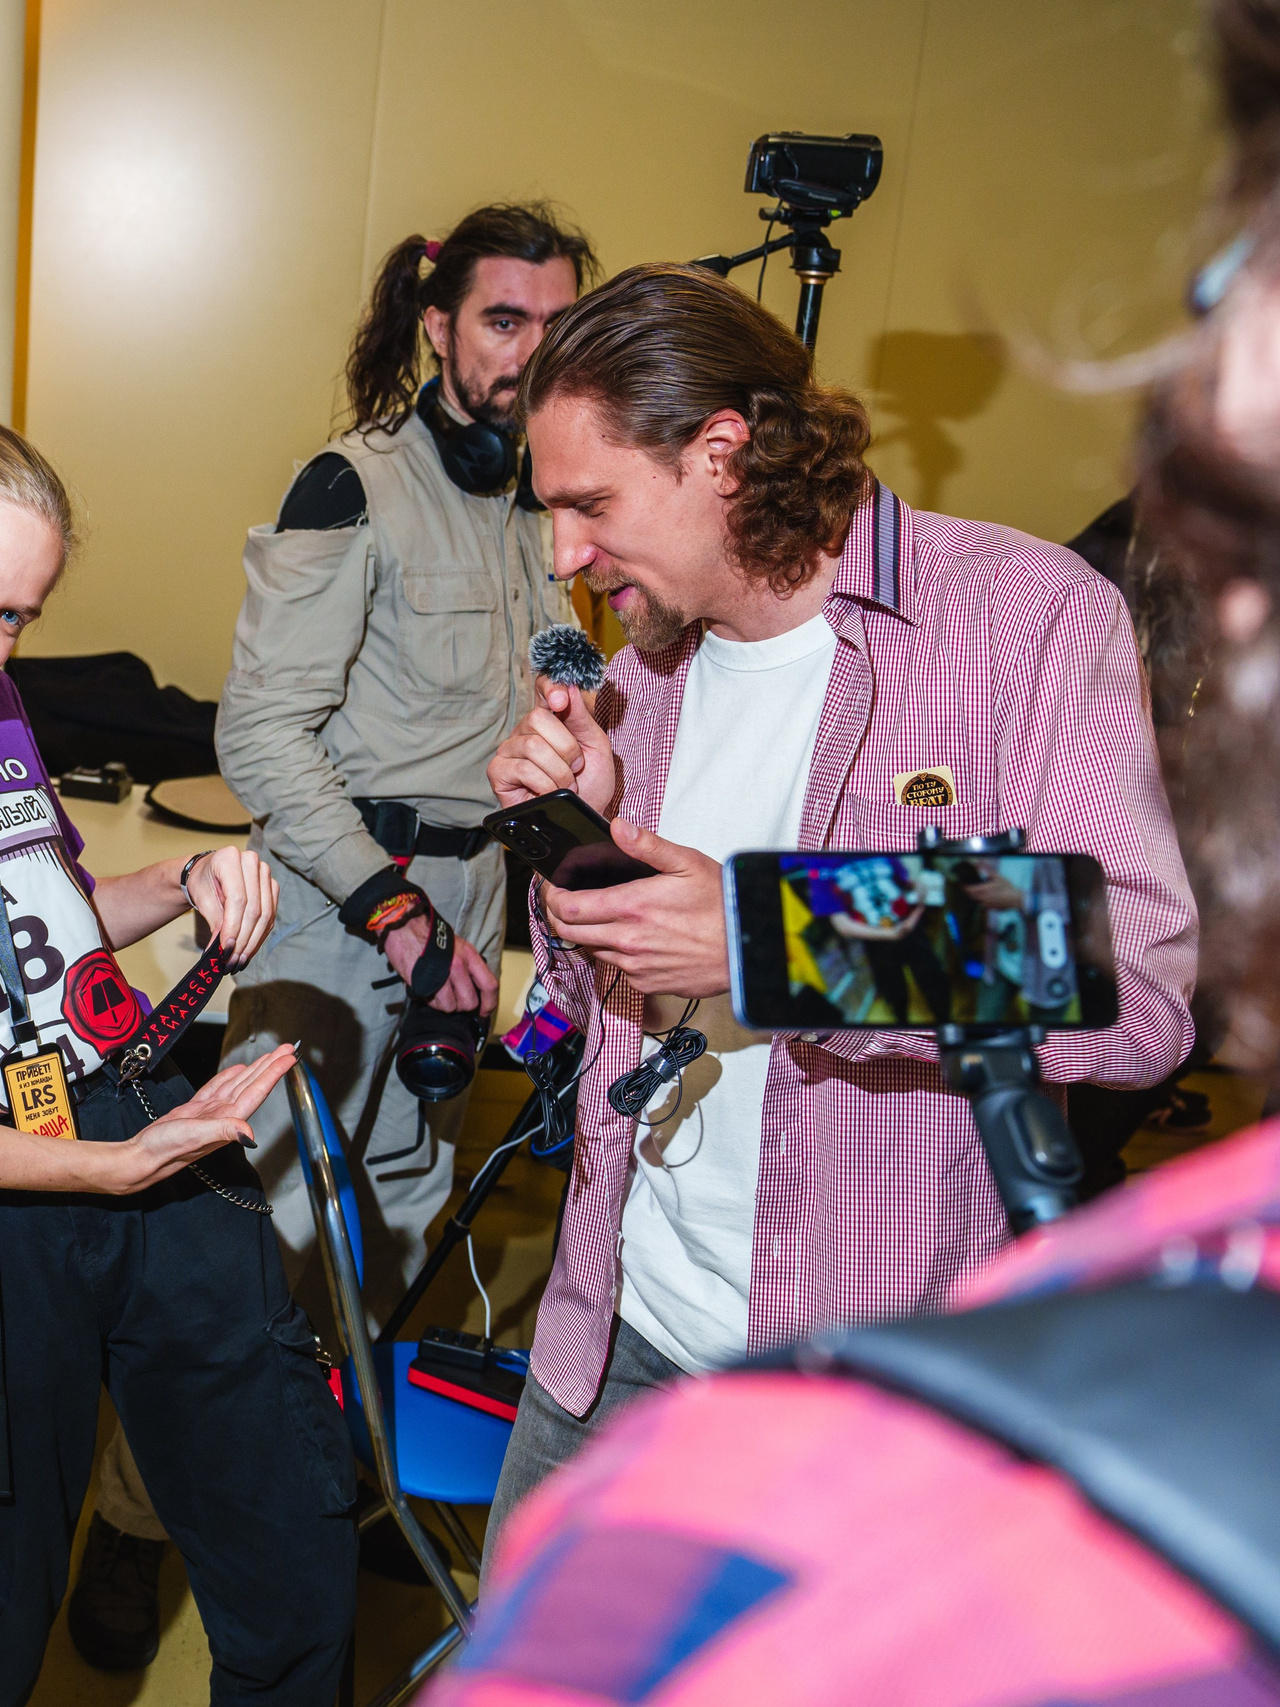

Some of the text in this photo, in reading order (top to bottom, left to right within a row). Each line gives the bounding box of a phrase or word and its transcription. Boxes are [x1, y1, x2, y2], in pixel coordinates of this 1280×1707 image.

[906, 786, 945, 799] СТОРОНУ
[912, 781, 937, 791] ПО ТУ
[436, 919, 447, 950] EOS
[16, 1063, 51, 1082] ПРИВЕТ!
[31, 1075, 53, 1086] КОМАНДЫ
[21, 1085, 56, 1111] LRS
[25, 1106, 59, 1121] МЕНЯ ЗОВУТ
